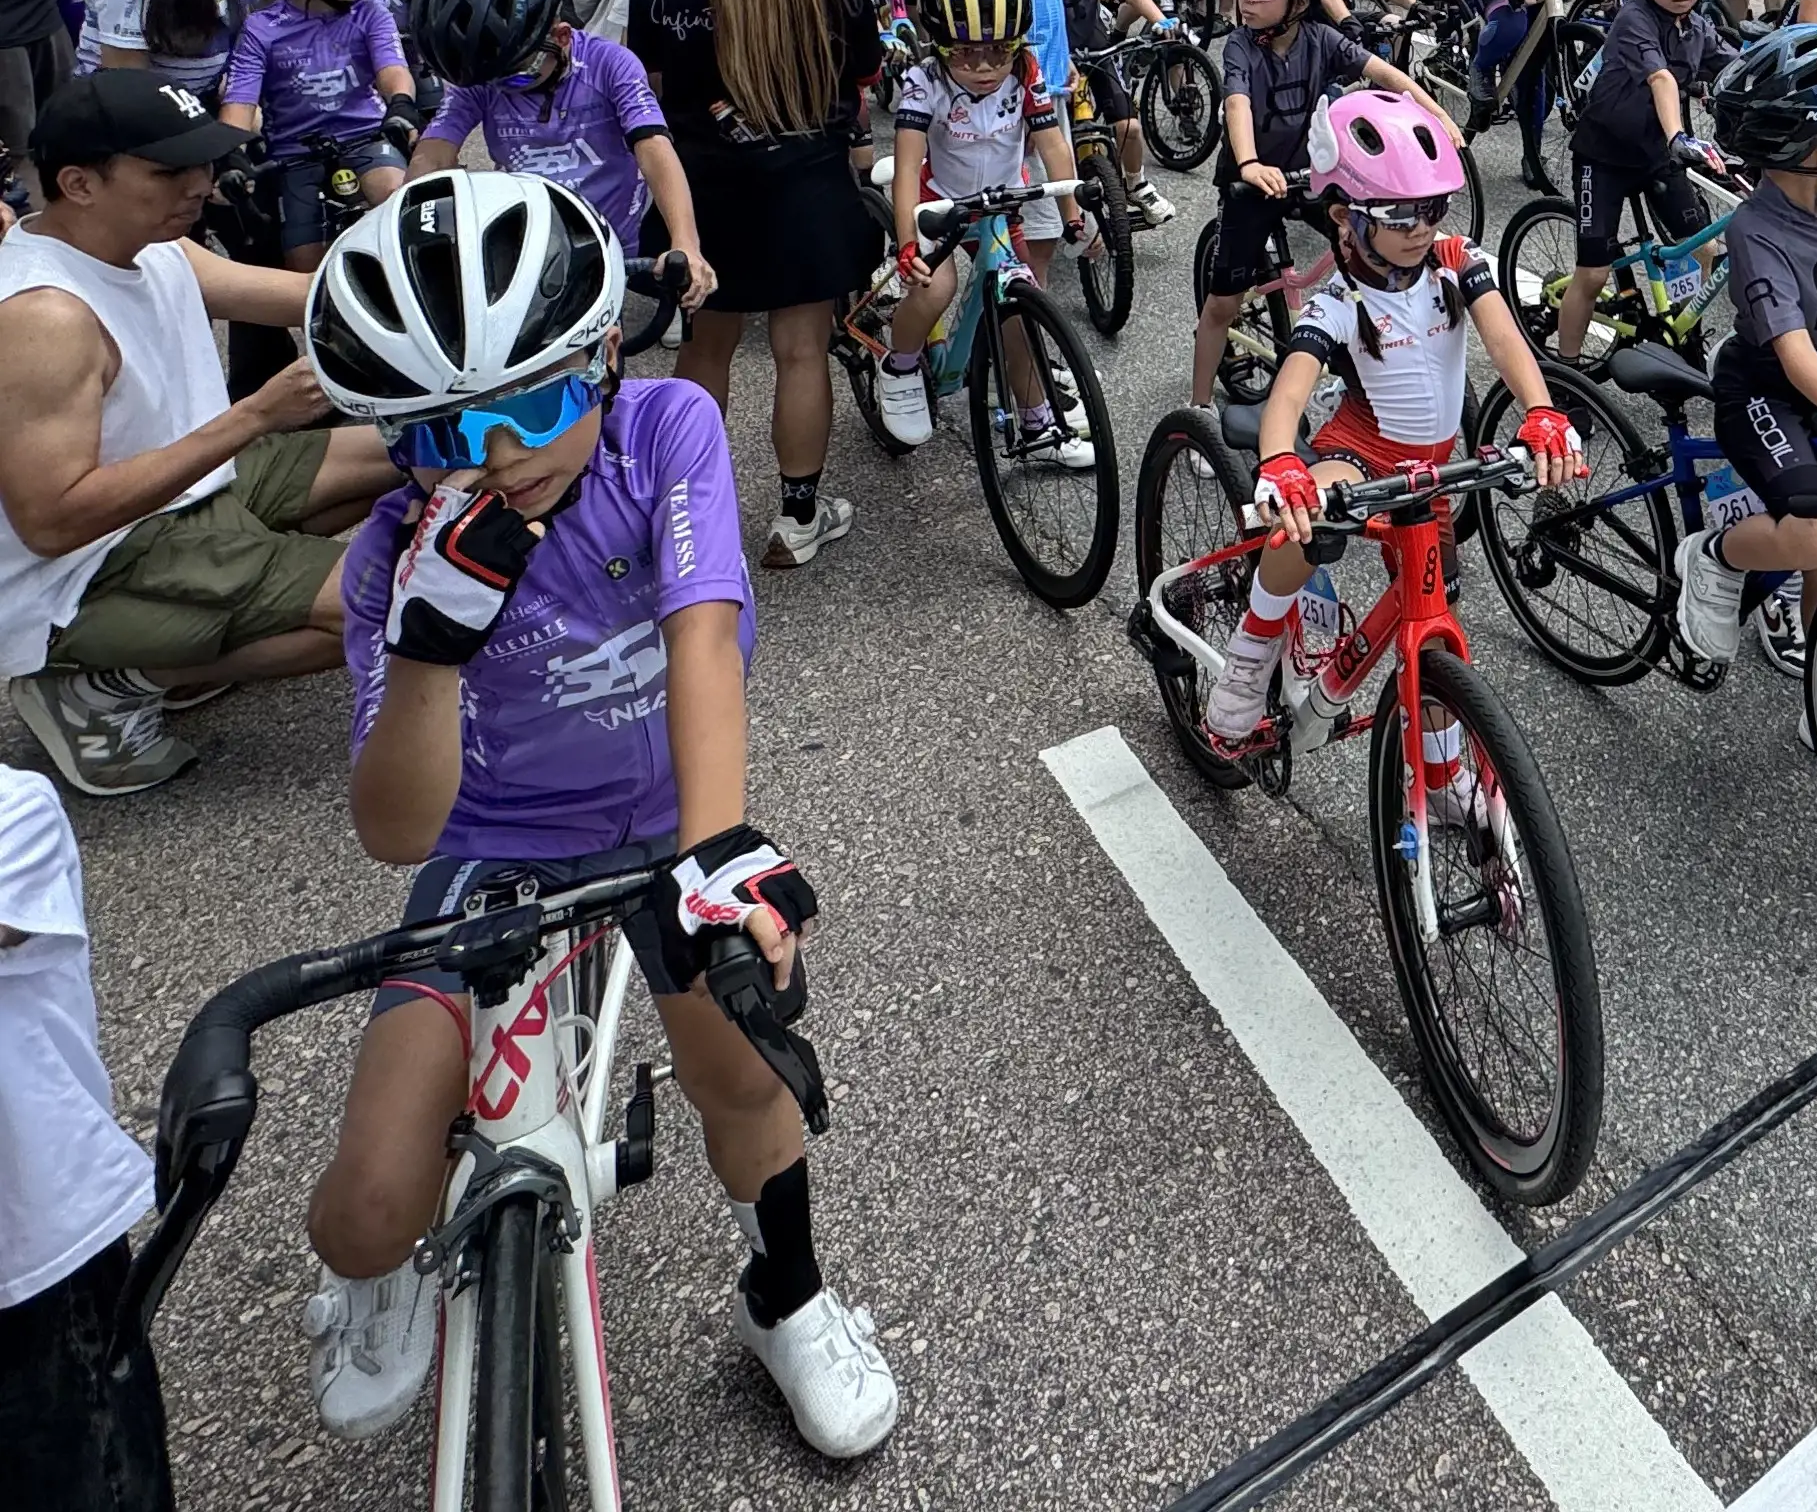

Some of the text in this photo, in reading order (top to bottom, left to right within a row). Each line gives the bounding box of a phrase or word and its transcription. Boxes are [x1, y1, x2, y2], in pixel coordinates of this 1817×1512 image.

[158, 84, 207, 120] LA
[1579, 165, 1594, 235] RECOIL
[1670, 276, 1696, 301] 265
[1718, 494, 1756, 526] 261
[1301, 595, 1329, 629] 251
[481, 617, 570, 658] ELEVATE
